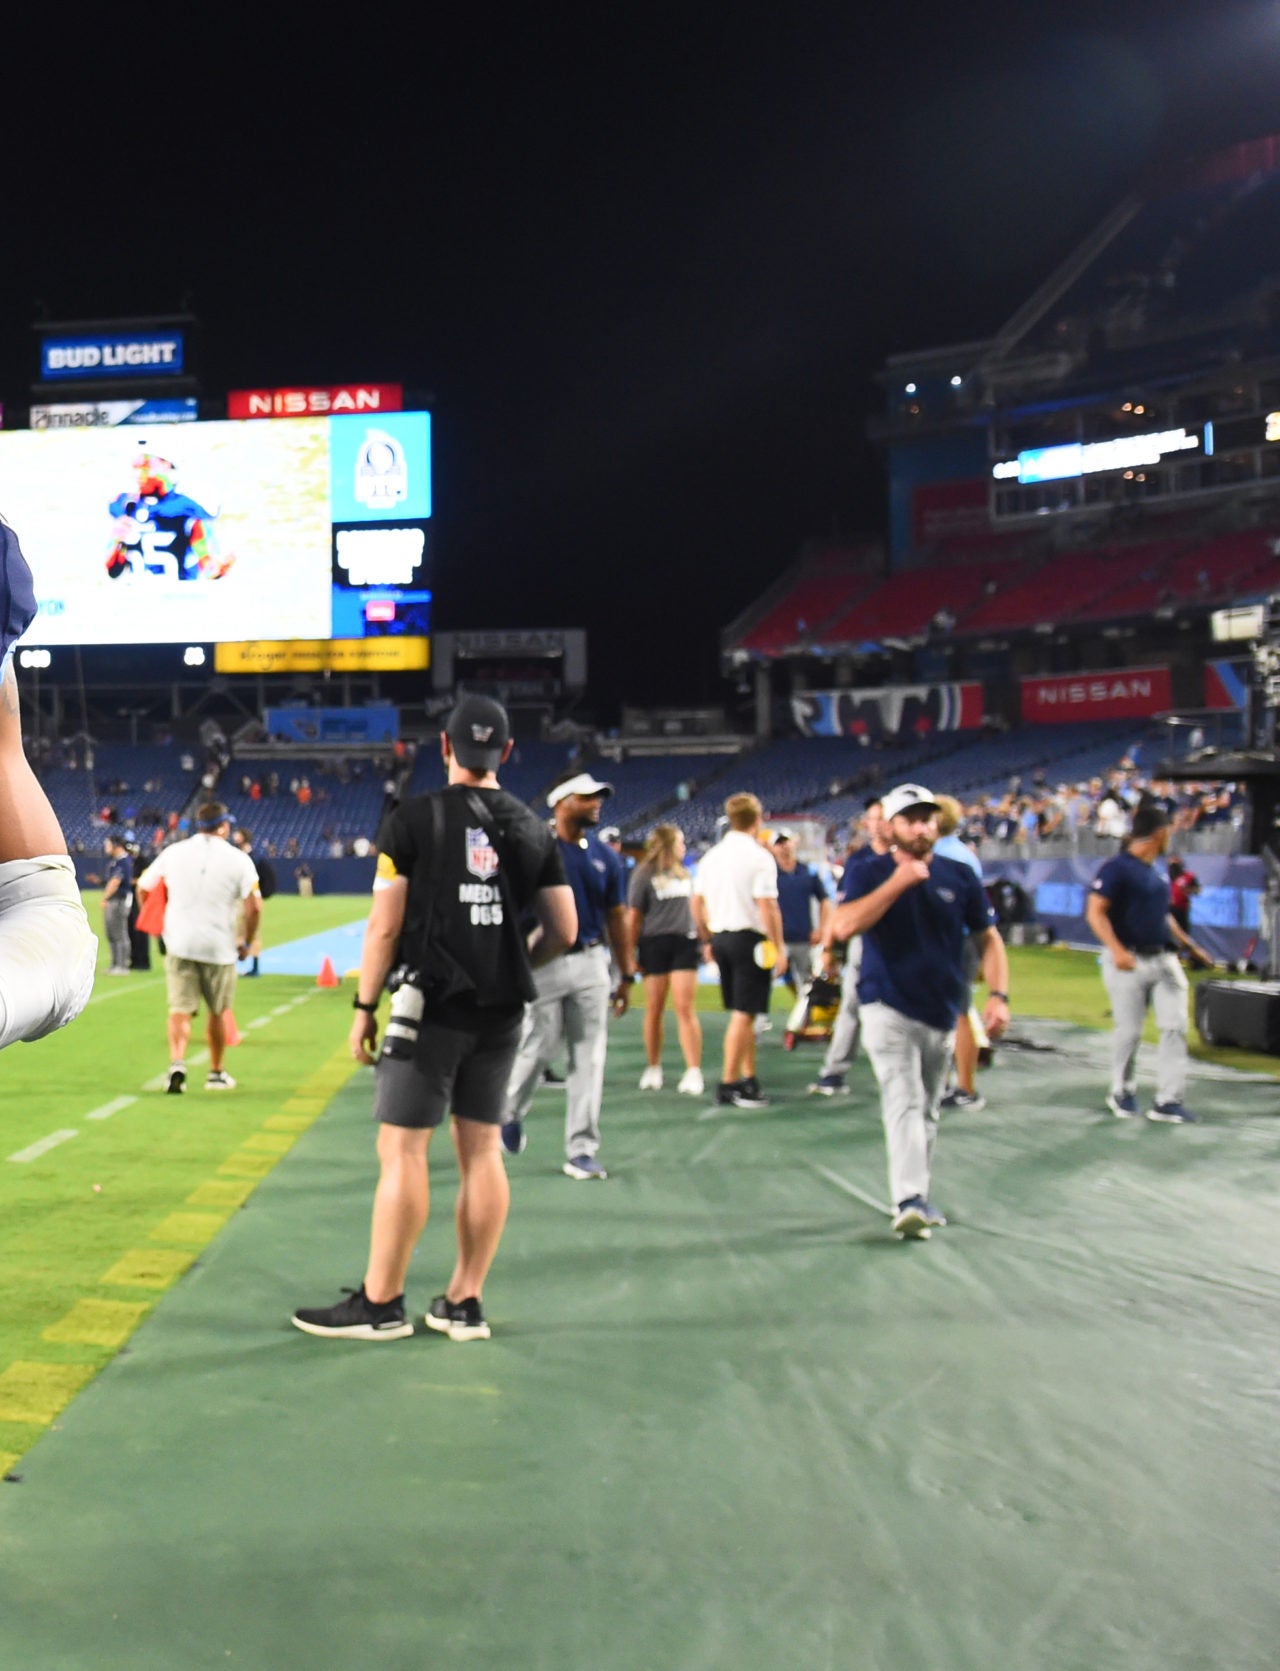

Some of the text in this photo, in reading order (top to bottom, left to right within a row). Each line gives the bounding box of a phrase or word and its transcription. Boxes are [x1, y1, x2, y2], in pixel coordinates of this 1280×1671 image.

[47, 341, 177, 370] BUD LIGHT
[248, 389, 381, 415] NISSAN
[1037, 678, 1151, 704] NISSAN
